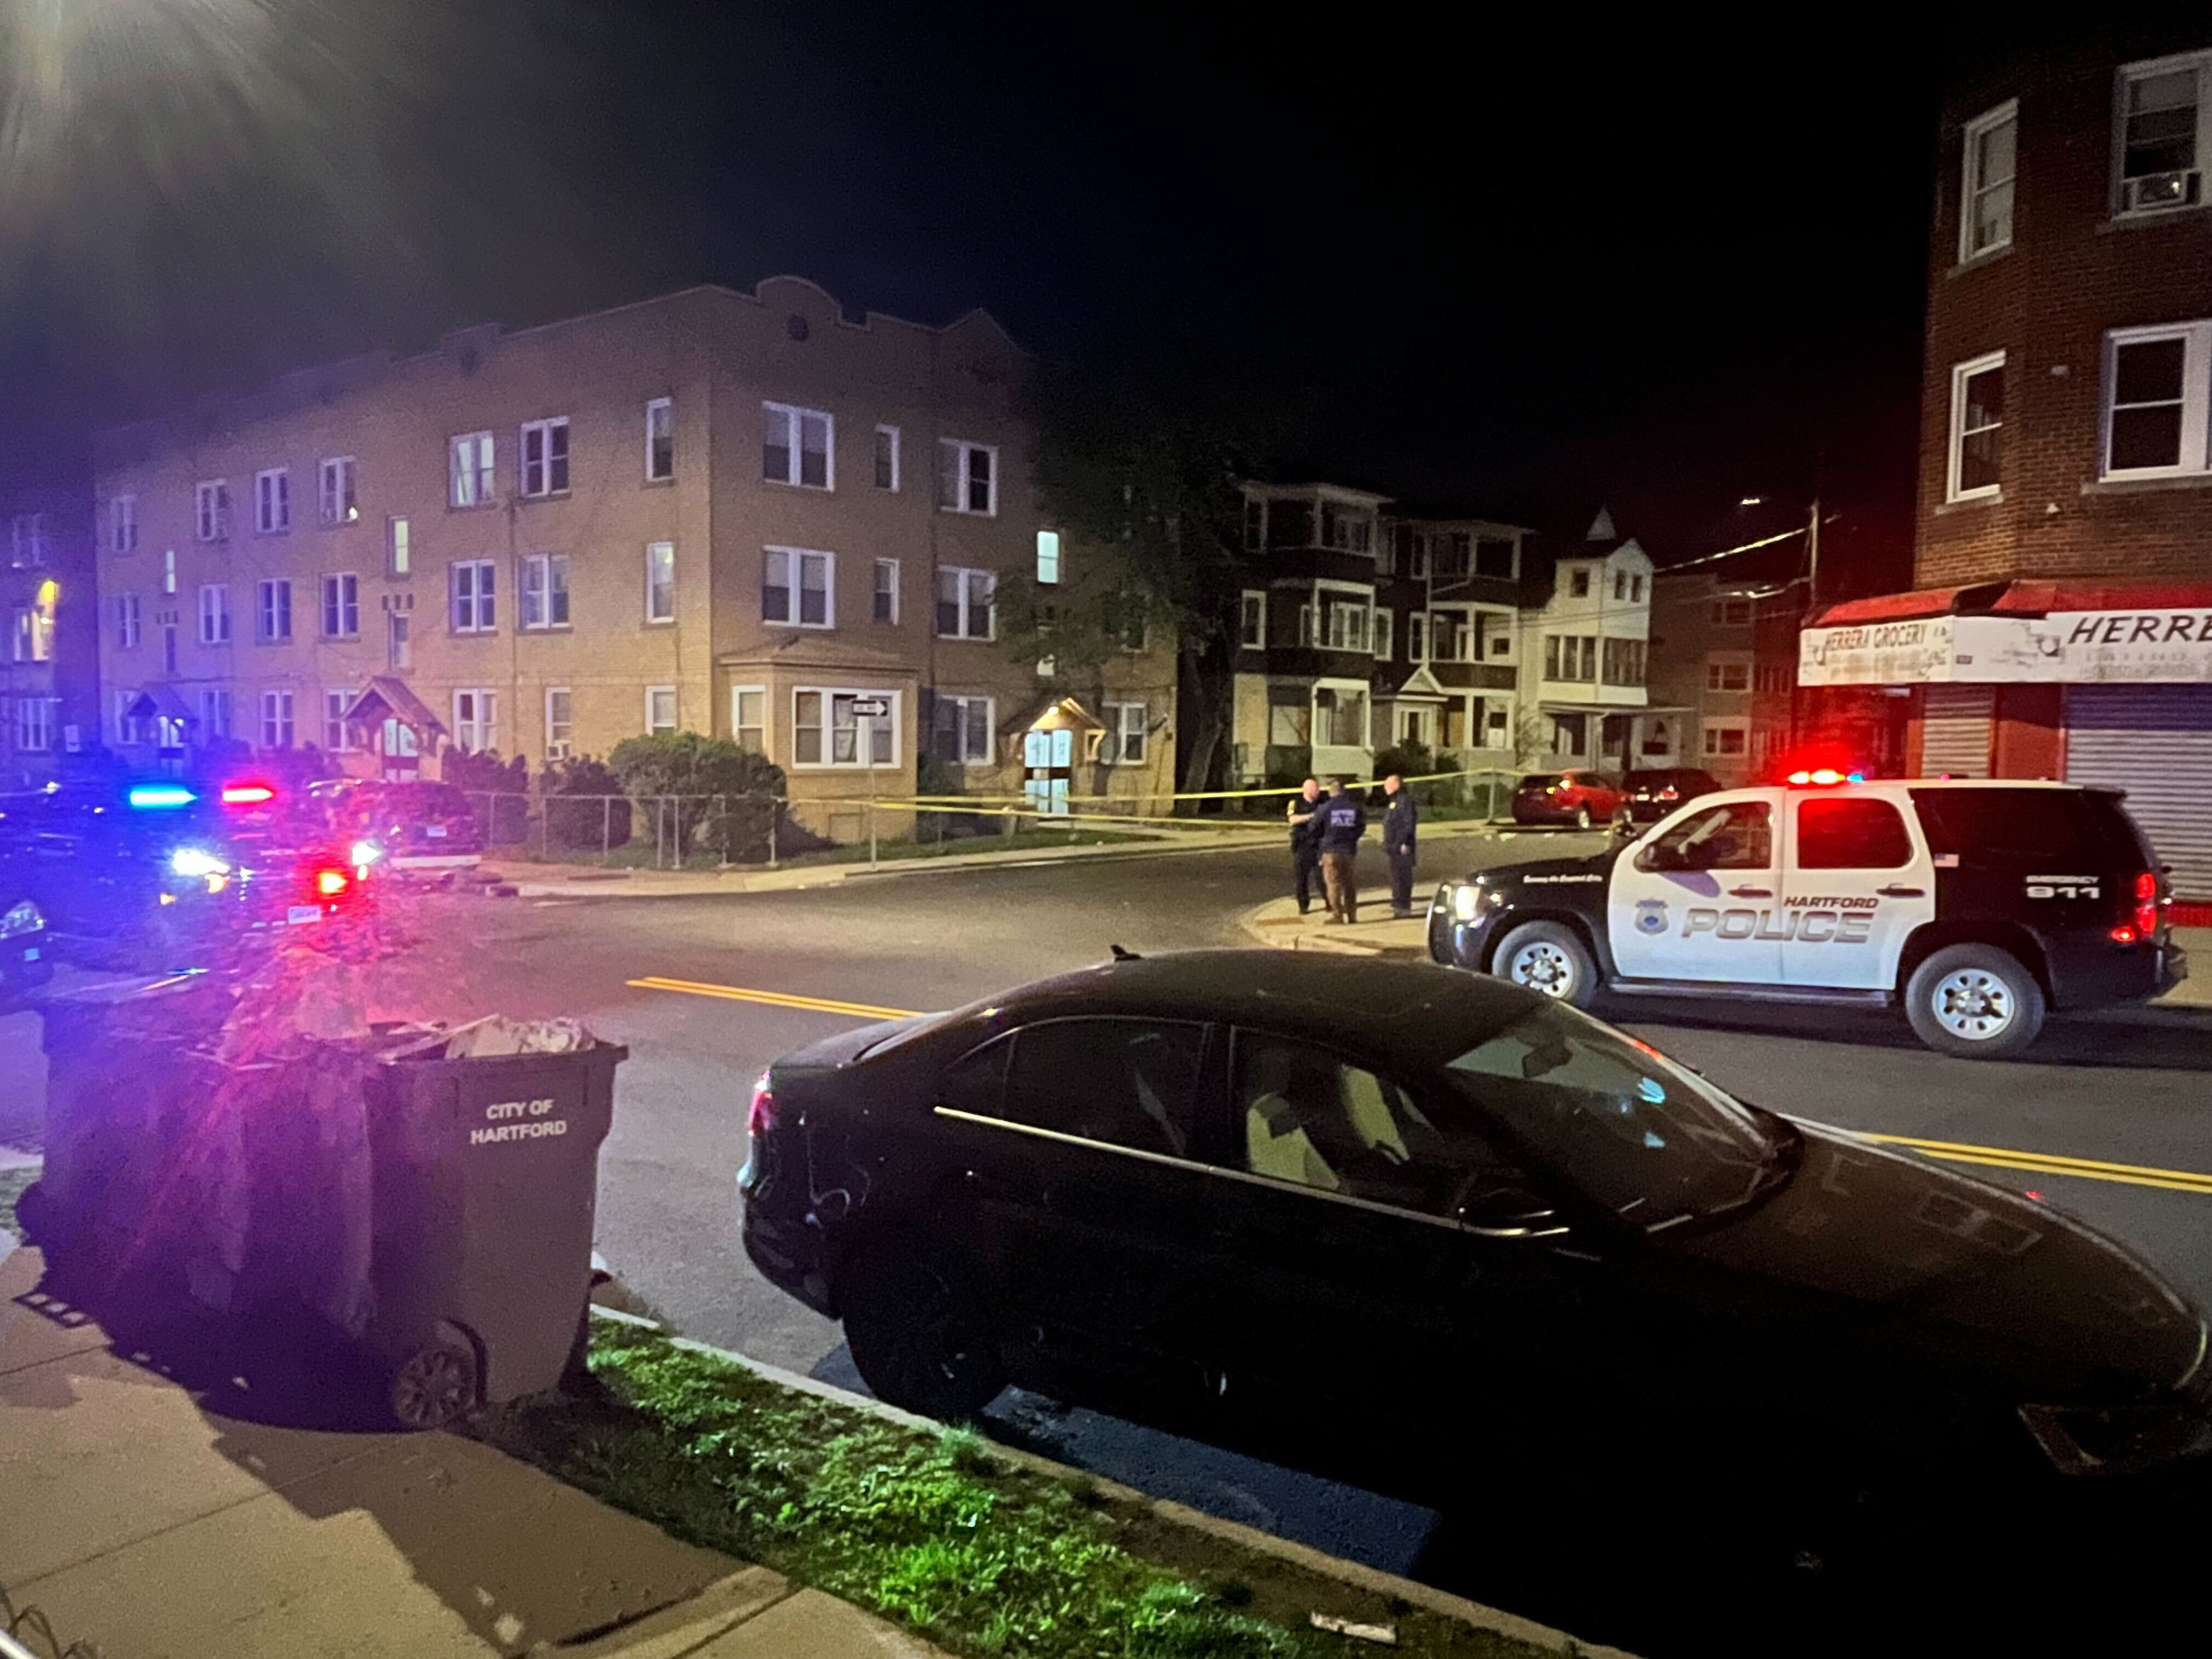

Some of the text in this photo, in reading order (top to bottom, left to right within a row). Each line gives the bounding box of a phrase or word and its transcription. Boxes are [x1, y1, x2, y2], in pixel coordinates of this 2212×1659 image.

[1874, 623, 1927, 648] GROCERY
[1784, 896, 1879, 909] HARTFORD
[1681, 908, 1874, 943] POLICE
[486, 1098, 555, 1120] CITY OF
[470, 1120, 567, 1144] HARTFORD
